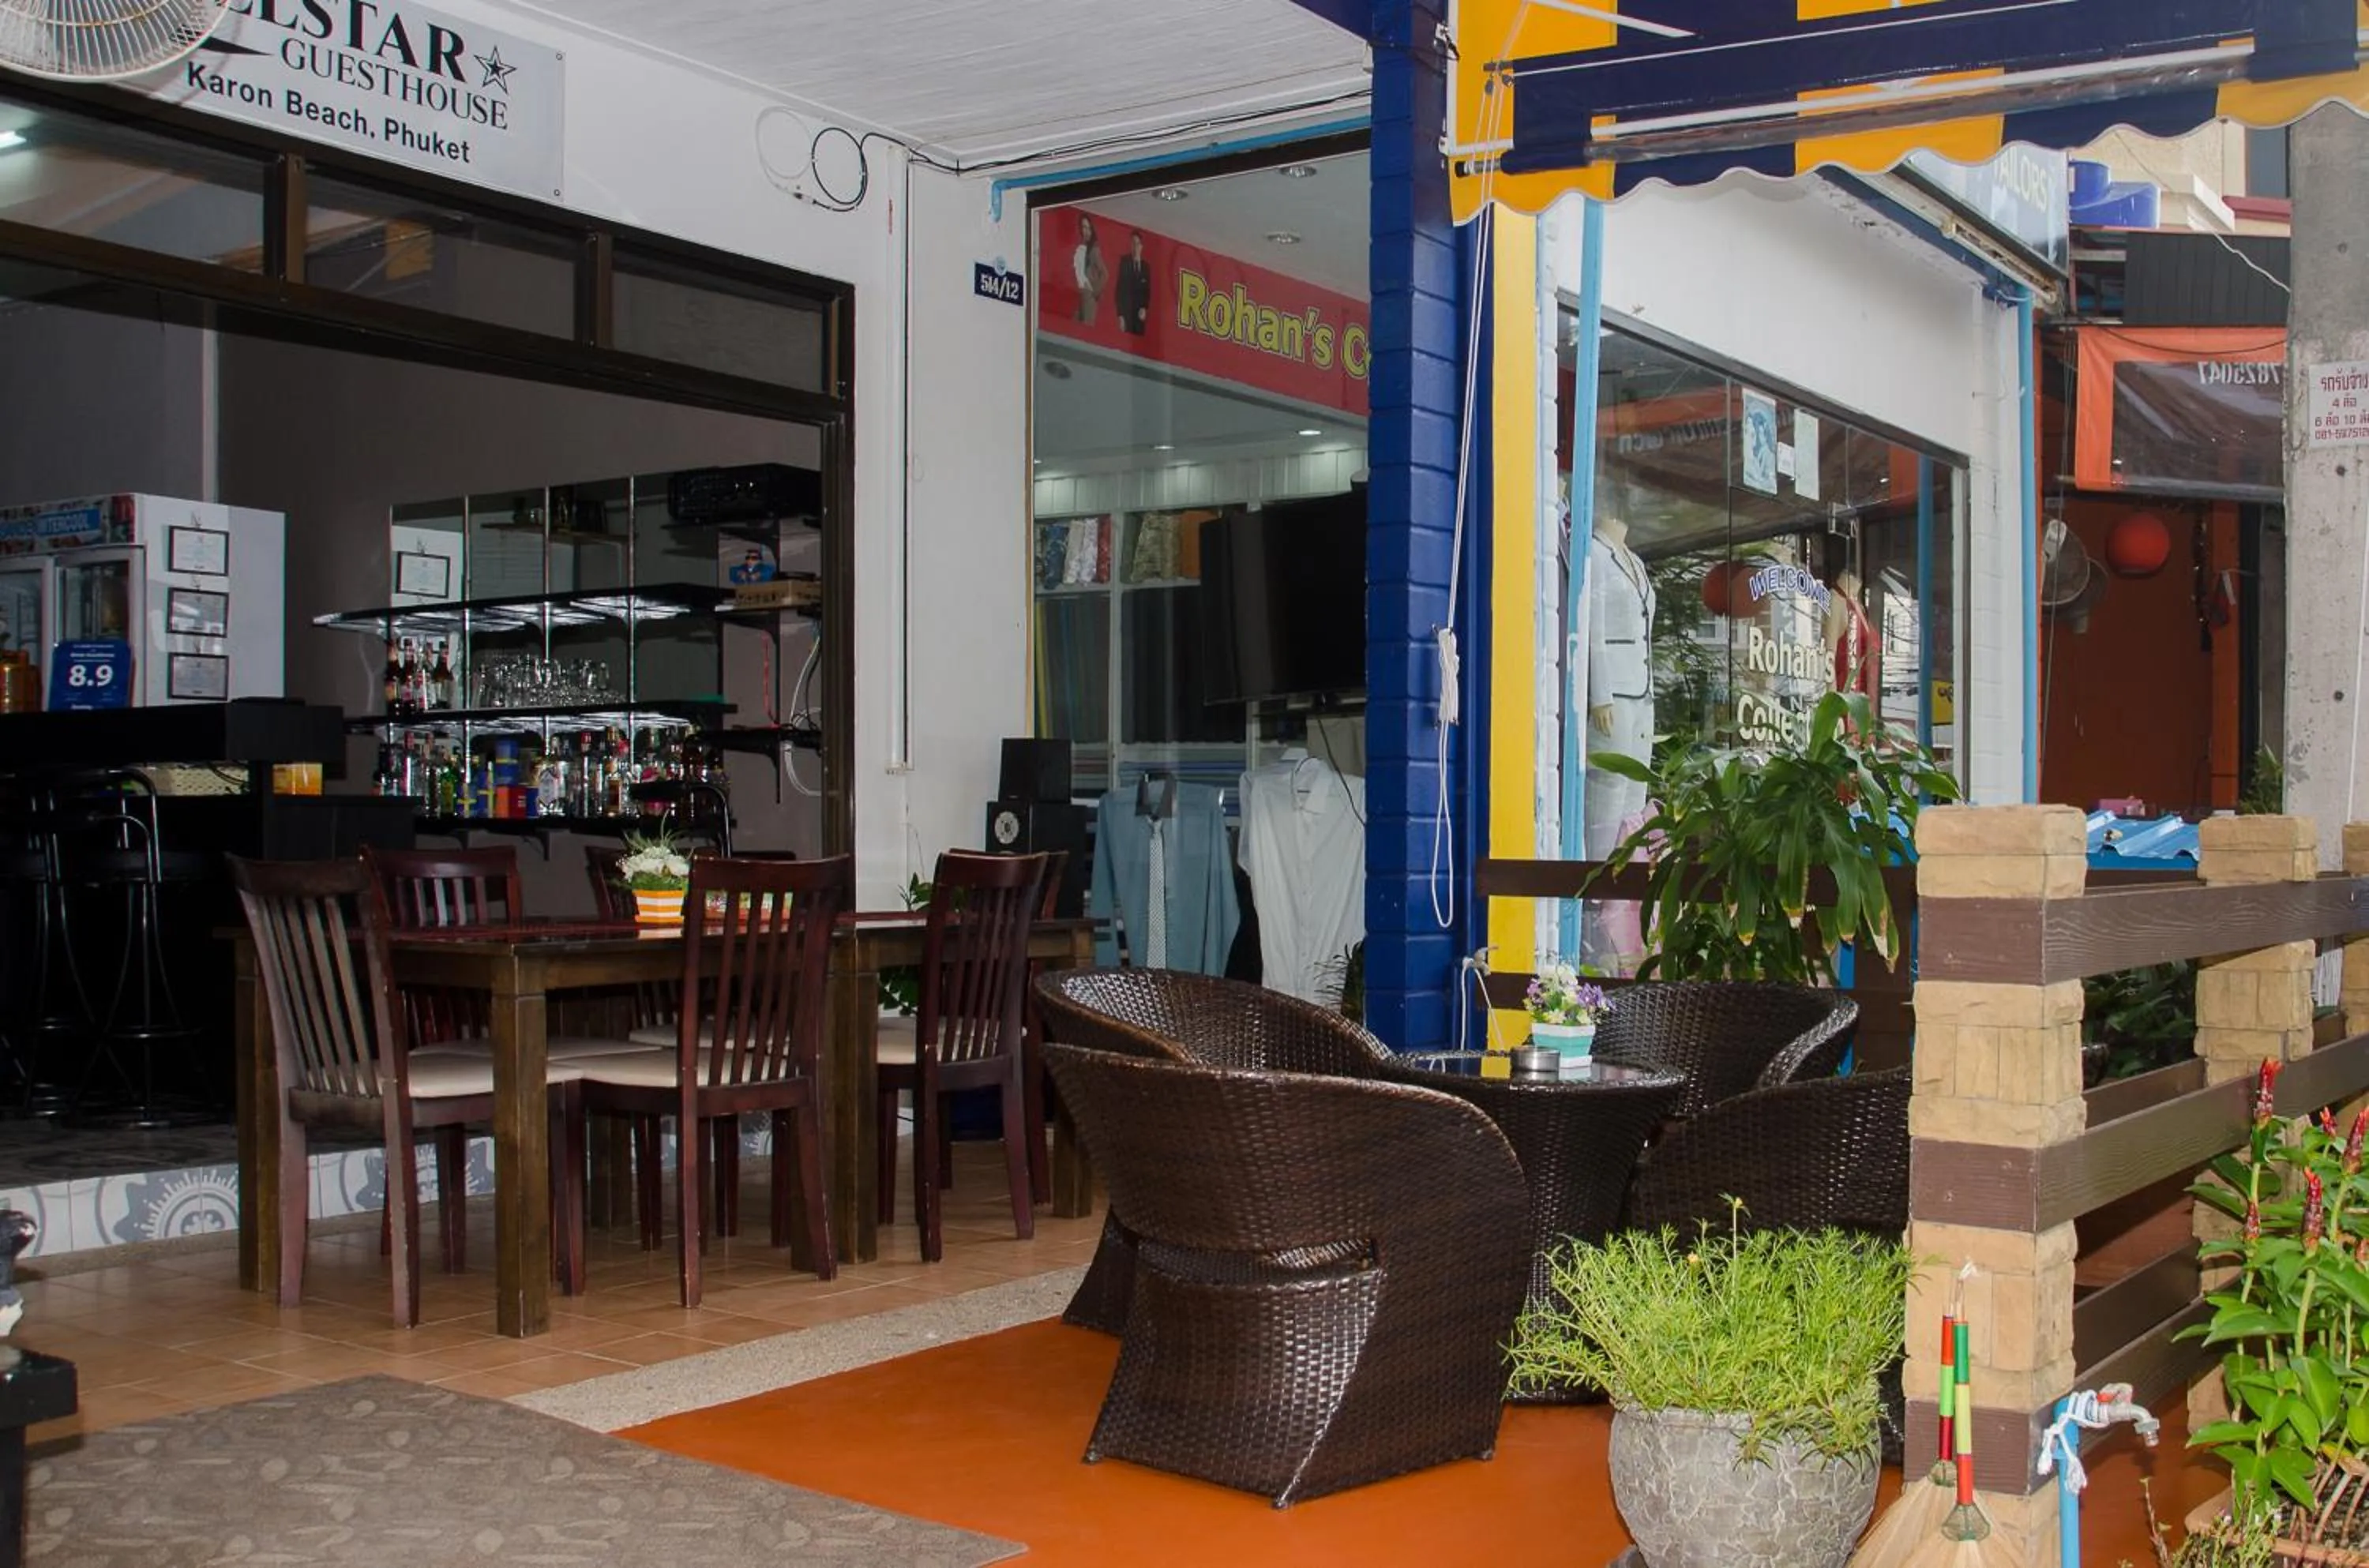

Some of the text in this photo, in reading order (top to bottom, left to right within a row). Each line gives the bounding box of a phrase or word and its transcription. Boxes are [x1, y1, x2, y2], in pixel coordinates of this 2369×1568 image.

[280, 37, 509, 130] GUESTHOUSE
[186, 61, 273, 109] Karon
[384, 118, 471, 163] Phuket
[980, 273, 1019, 300] 514/12
[1177, 268, 1372, 379] Rohan's C
[2315, 416, 2322, 427] 6
[2345, 414, 2356, 425] 10
[2332, 397, 2339, 407] 4
[1748, 565, 1832, 618] WELCOME
[69, 664, 114, 687] 8.9
[1748, 626, 1835, 684] Rohan's
